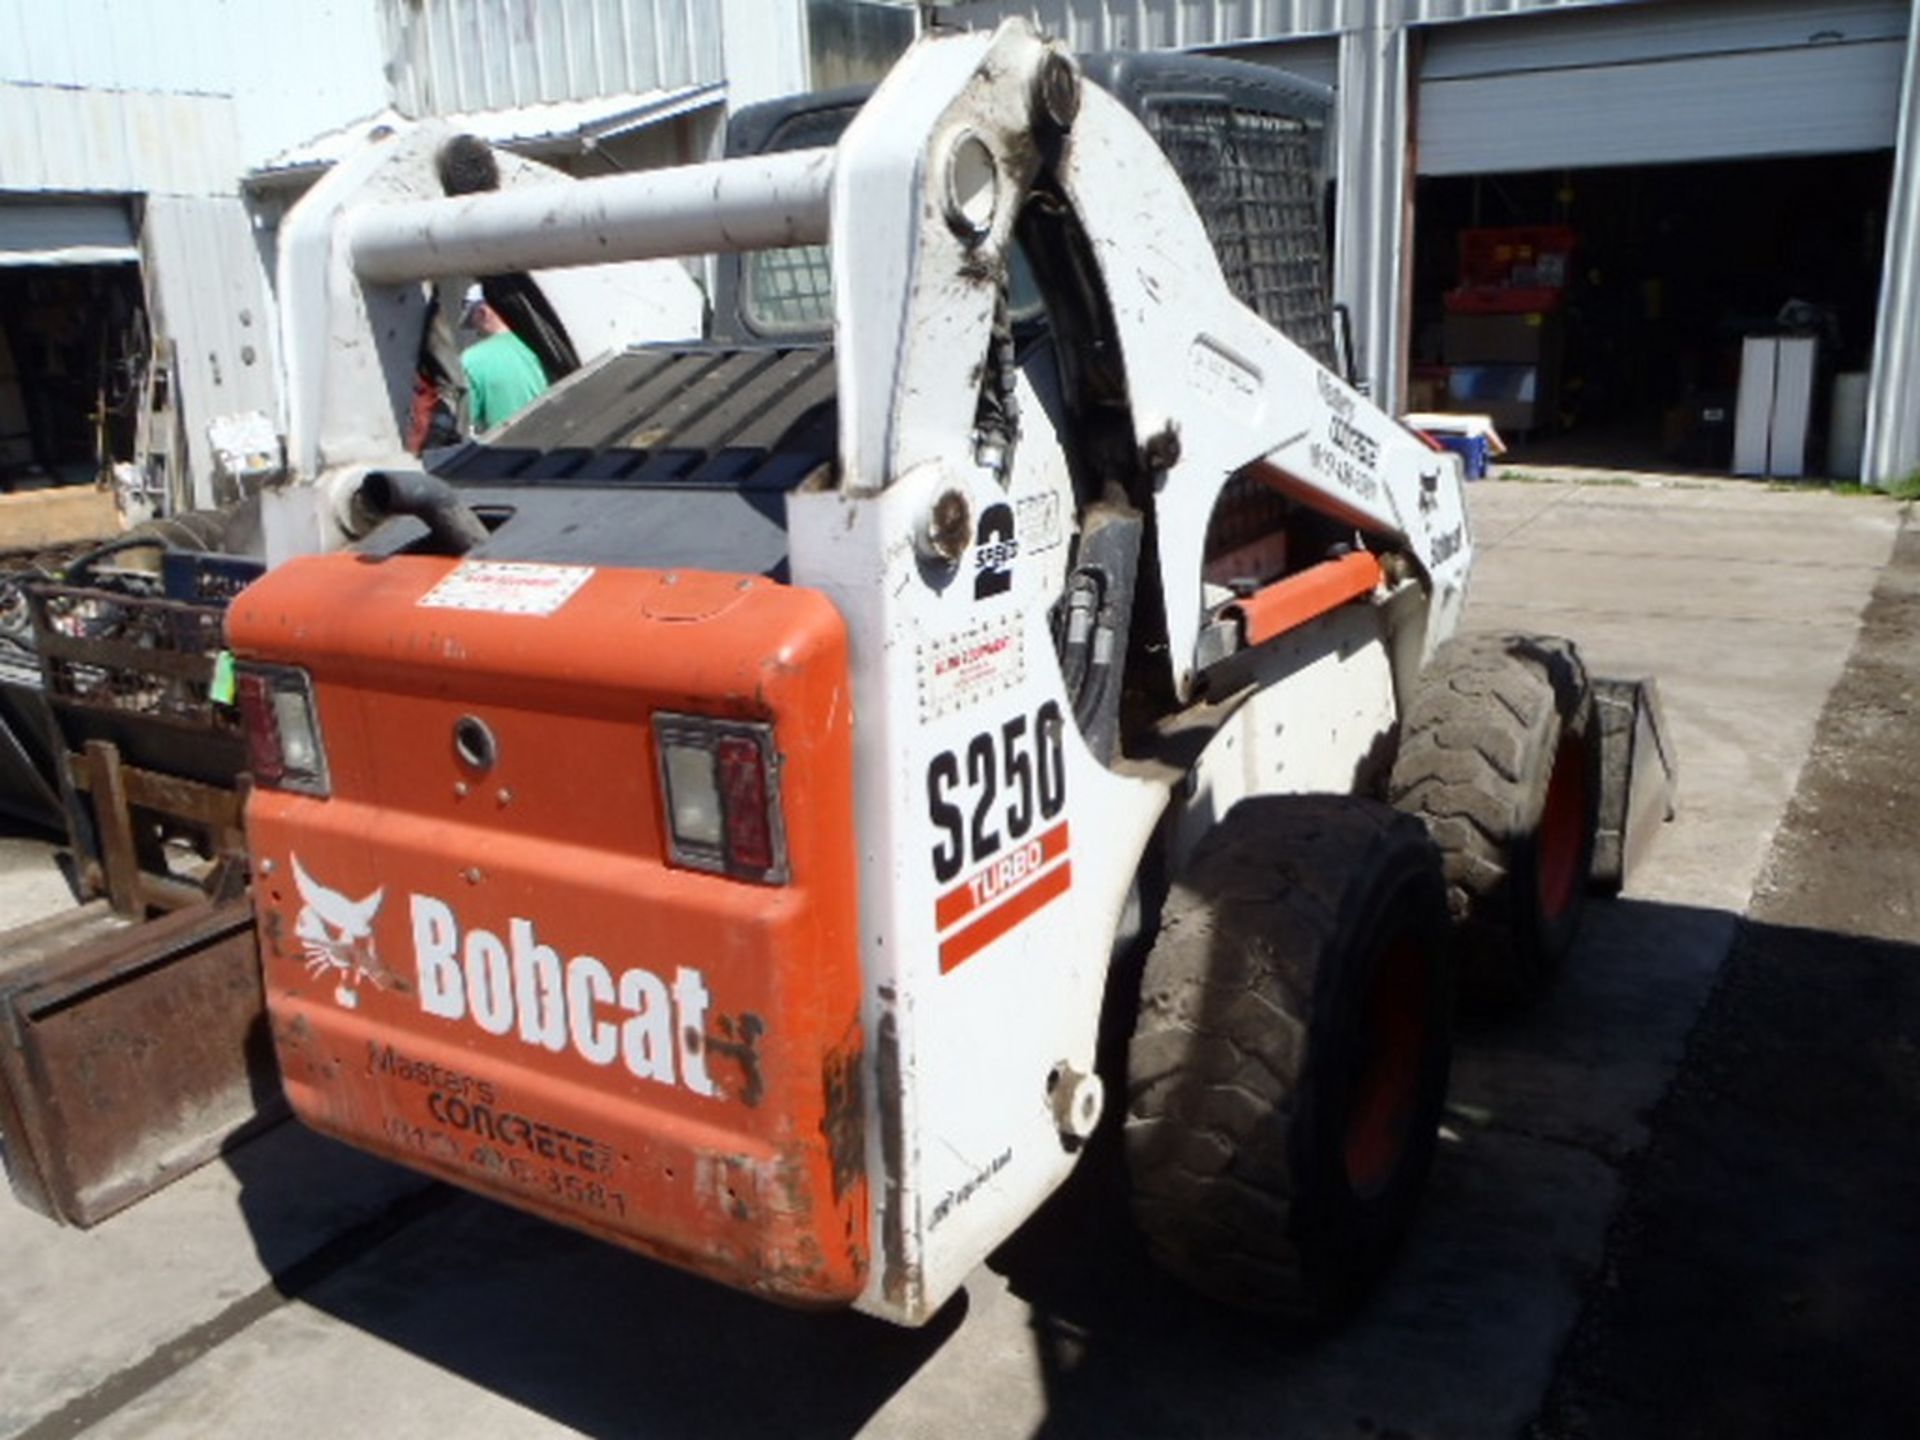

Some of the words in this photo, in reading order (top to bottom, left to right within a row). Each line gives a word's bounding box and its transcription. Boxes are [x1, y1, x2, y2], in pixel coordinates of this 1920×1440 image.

[926, 698, 1066, 885] S250
[967, 838, 1044, 909] TURBO
[409, 893, 726, 1100] Bobcat
[366, 1040, 496, 1106] Masters
